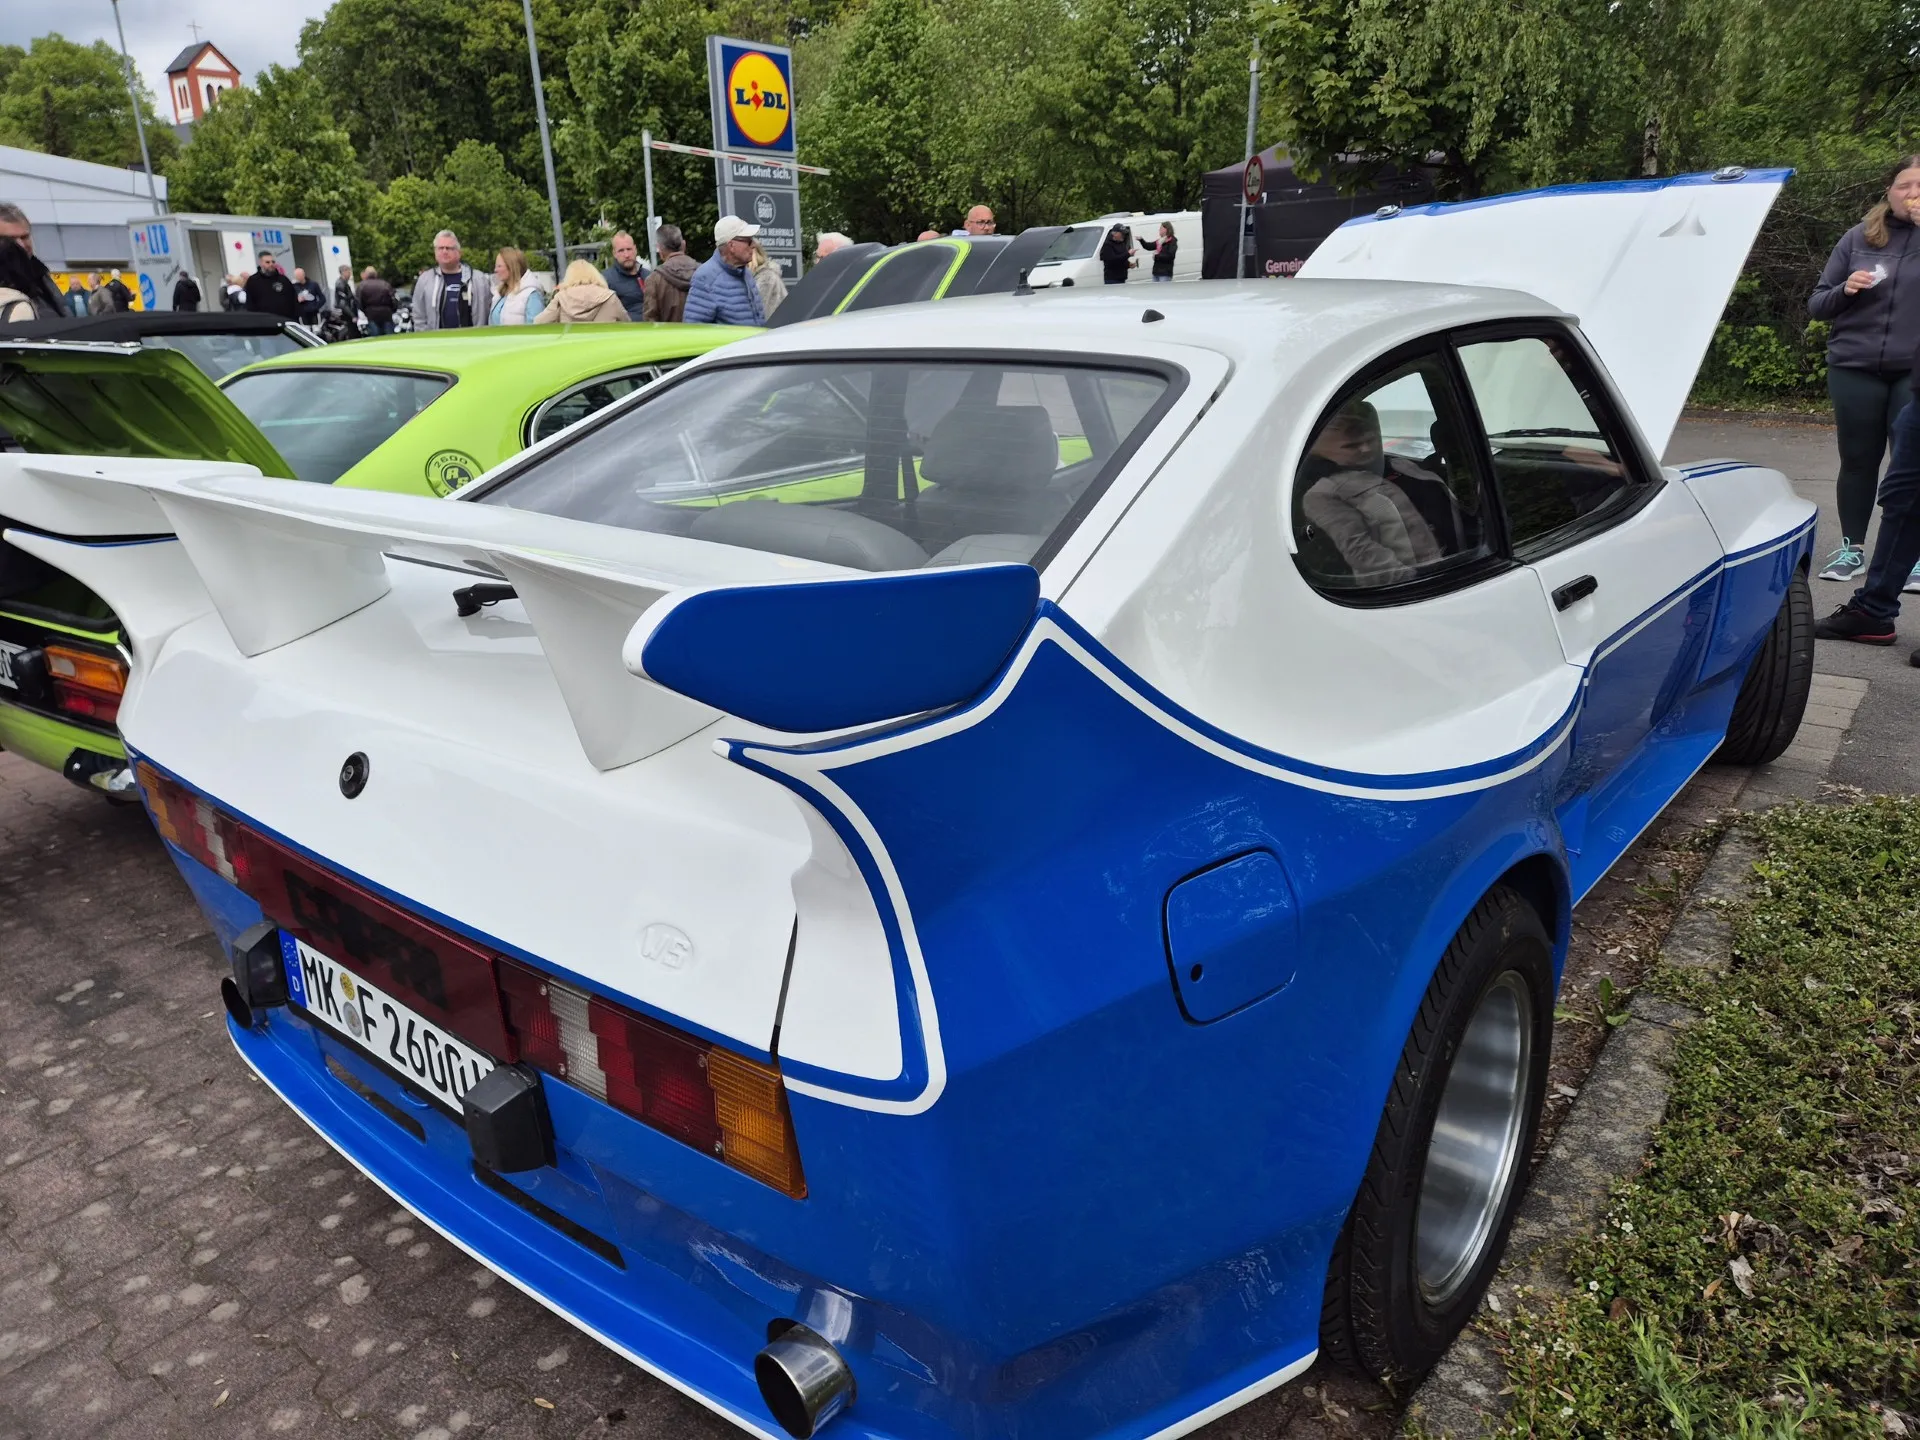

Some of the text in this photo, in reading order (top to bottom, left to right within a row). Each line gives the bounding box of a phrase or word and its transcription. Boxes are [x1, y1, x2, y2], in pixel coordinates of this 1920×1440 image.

[733, 164, 791, 180] Lidl lohnt sich.
[264, 230, 282, 244] LTB
[434, 455, 468, 468] 2600
[291, 975, 301, 993] D
[299, 947, 492, 1101] MK F 2600
